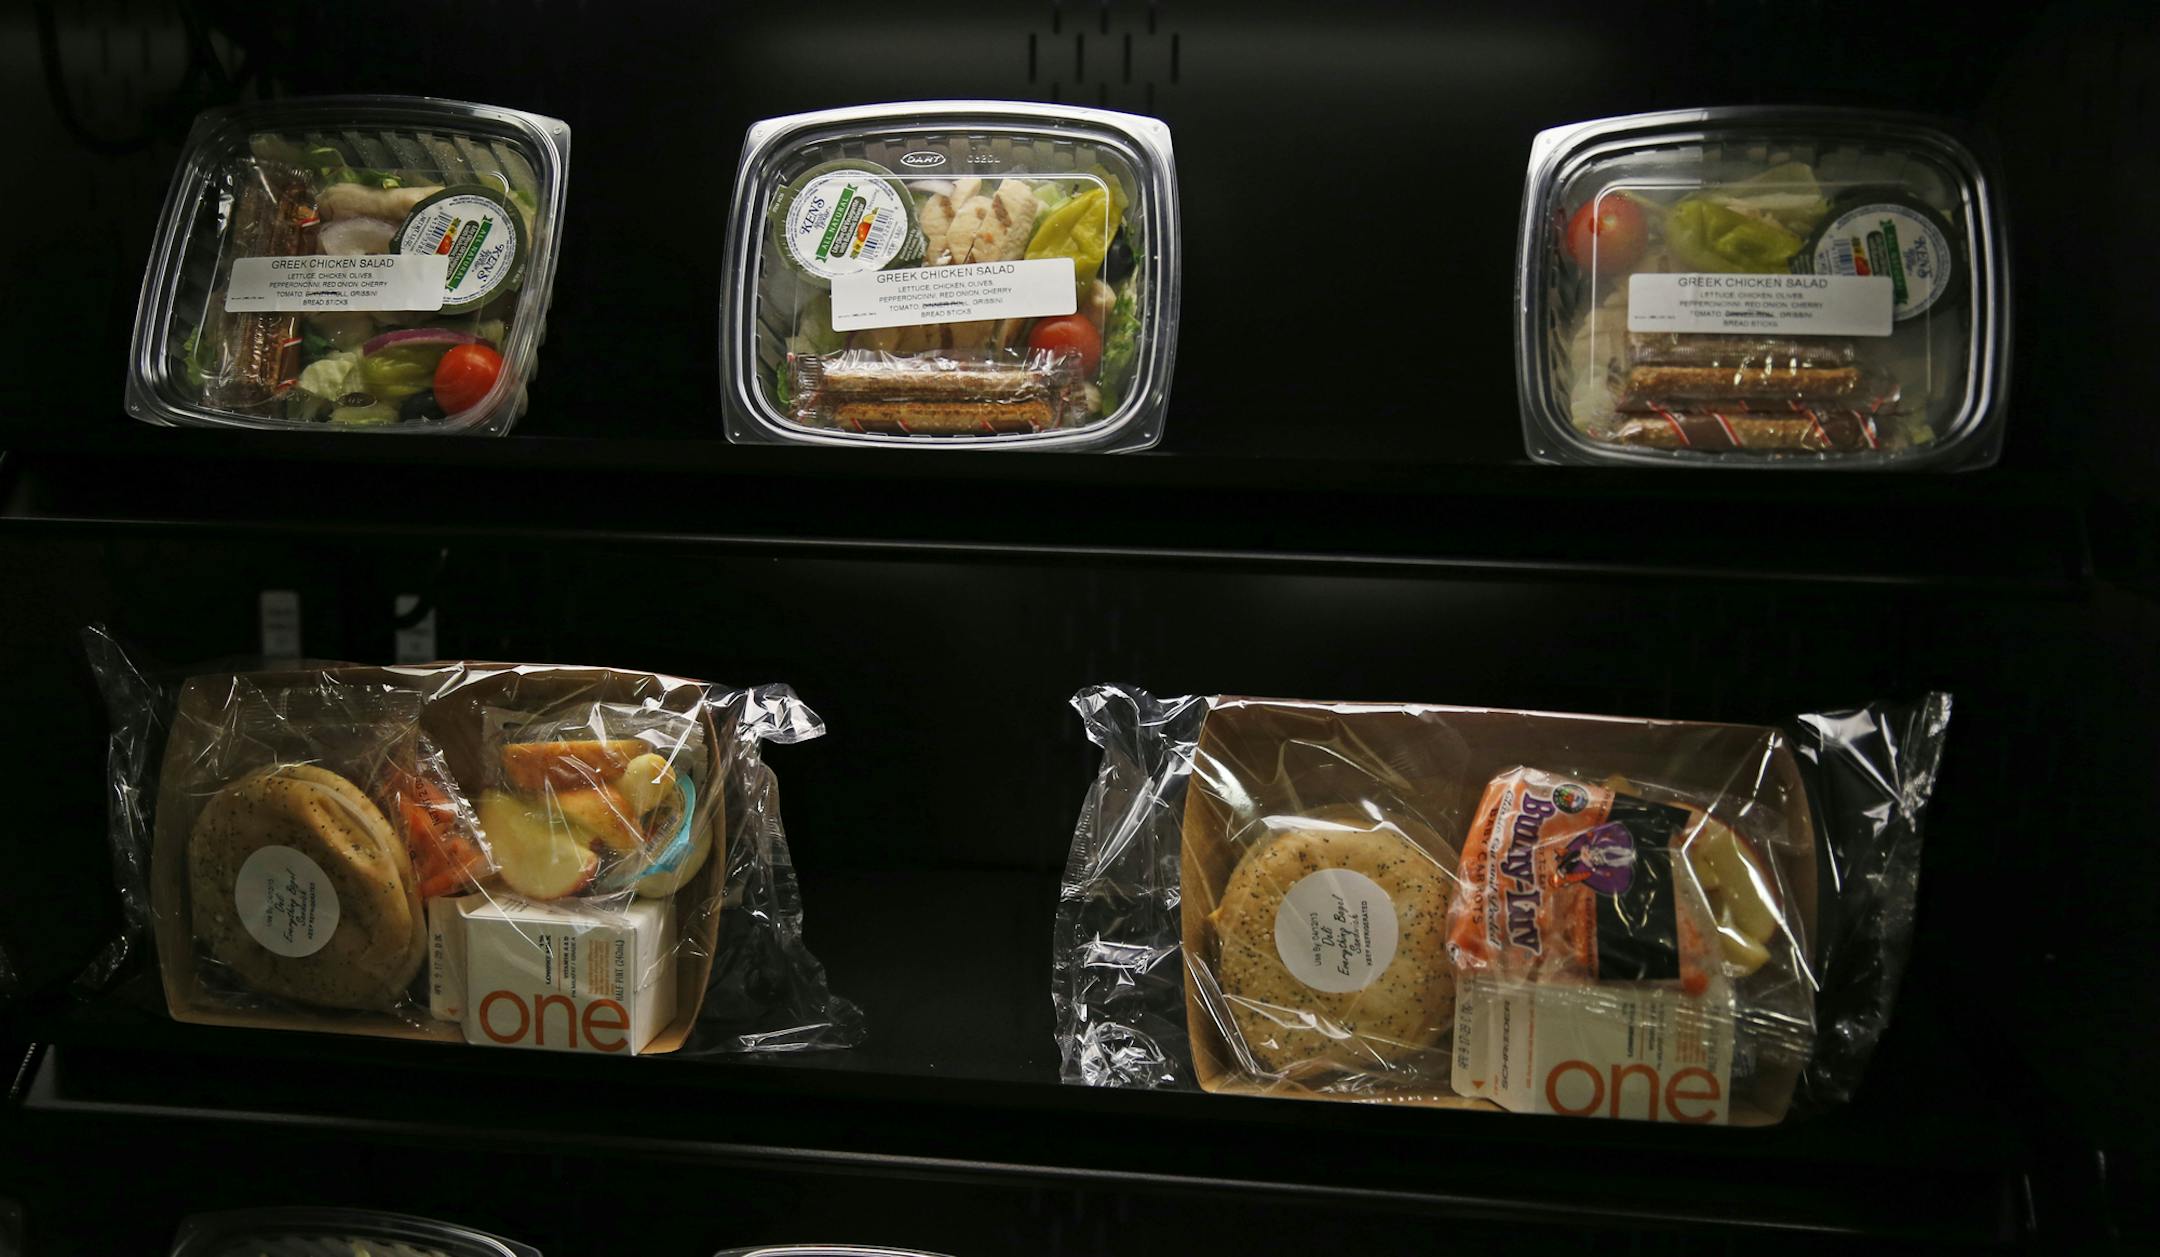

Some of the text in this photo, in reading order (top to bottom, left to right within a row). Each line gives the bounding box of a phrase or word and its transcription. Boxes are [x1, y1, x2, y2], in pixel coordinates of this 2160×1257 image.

[800, 196, 824, 234] KEN'S
[822, 198, 850, 250] ALL NATURAL
[272, 258, 394, 269] GREEK CHICKEN SALAD
[456, 229, 486, 280] ALL NATURAL
[877, 264, 1014, 284] GREEK CHICKEN SALAD
[940, 290, 954, 298] RED
[982, 287, 1012, 296] CHERRY
[1679, 277, 1828, 289] GREEK CHICKEN SALAD
[921, 308, 972, 318] BREAD STICKS
[1472, 808, 1499, 924] BABY CARROTS
[1500, 792, 1556, 953] Bunny-Luv
[1321, 926, 1334, 947] Deli
[1332, 893, 1354, 976] Everything Bagel
[480, 990, 630, 1051] one
[1545, 1059, 1720, 1124] one
